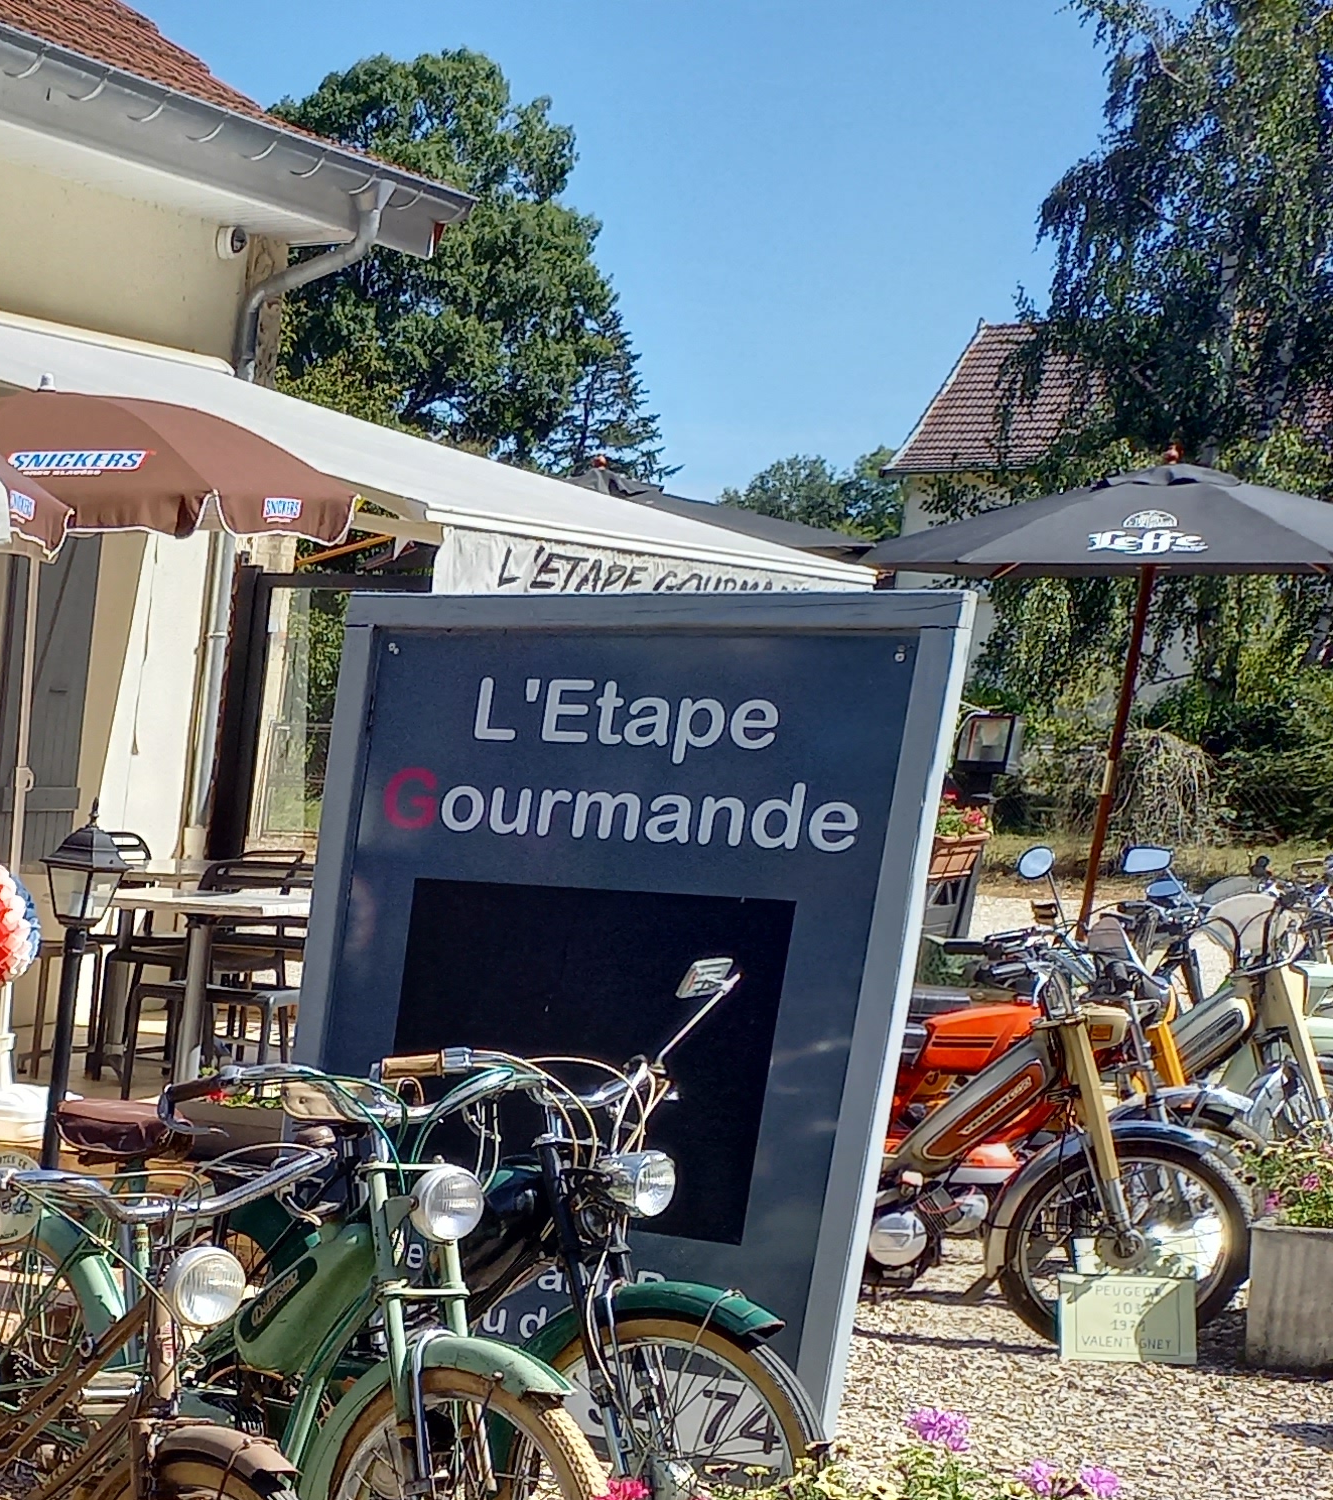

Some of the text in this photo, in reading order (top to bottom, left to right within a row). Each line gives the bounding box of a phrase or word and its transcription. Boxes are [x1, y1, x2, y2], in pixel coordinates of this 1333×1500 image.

[13, 453, 143, 468] SNICKERS
[472, 676, 781, 765] L'Etape
[382, 766, 861, 853] Gourmande
